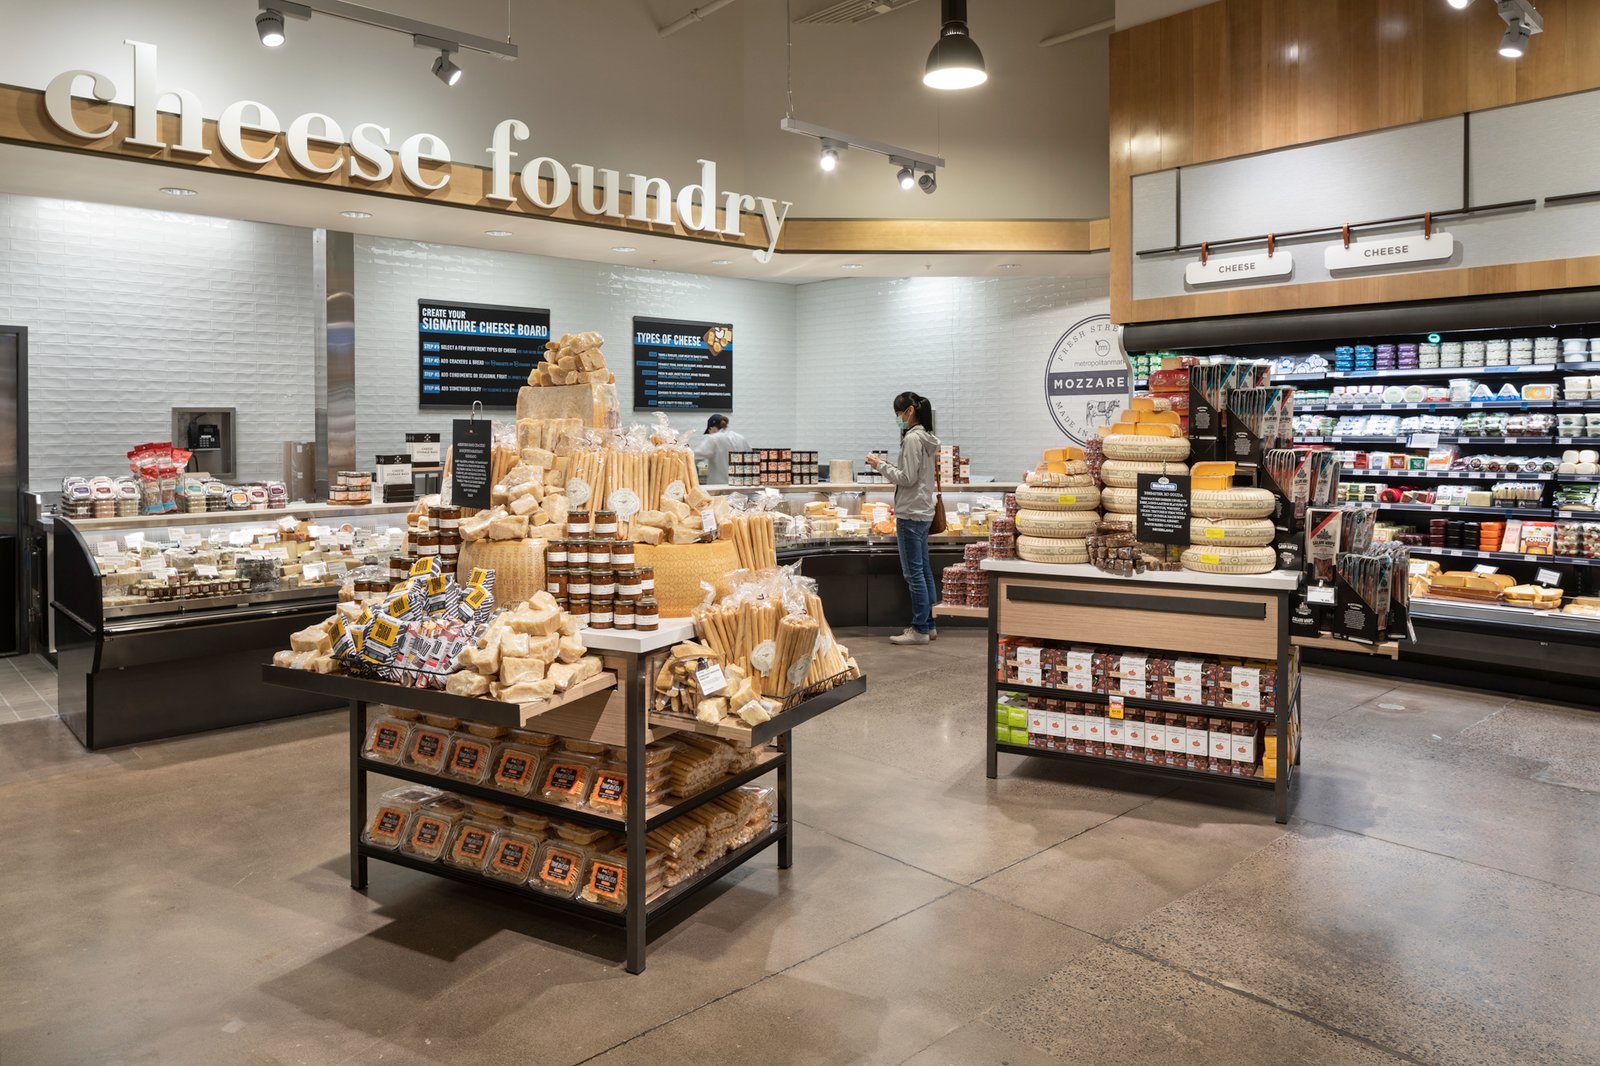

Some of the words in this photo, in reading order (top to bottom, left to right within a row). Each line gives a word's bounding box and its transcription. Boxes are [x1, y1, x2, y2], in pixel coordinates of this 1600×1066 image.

[45, 40, 451, 191] cheese
[486, 119, 793, 263] foundry
[1364, 244, 1409, 258] CHEESE
[1218, 262, 1256, 274] CHEESE
[422, 308, 446, 318] CREATE
[448, 310, 466, 320] YOUR
[422, 318, 476, 332] SIGNATURE
[480, 322, 515, 335] CHEESE
[518, 324, 548, 337] BOARD
[636, 332, 660, 344] TYPES
[662, 334, 672, 344] OF
[674, 335, 702, 346] CHEESE
[1058, 332, 1086, 362] FRESH
[1074, 360, 1126, 368] metropolitanmar
[1054, 377, 1129, 389] MOZZARE
[1056, 401, 1076, 428] MADE
